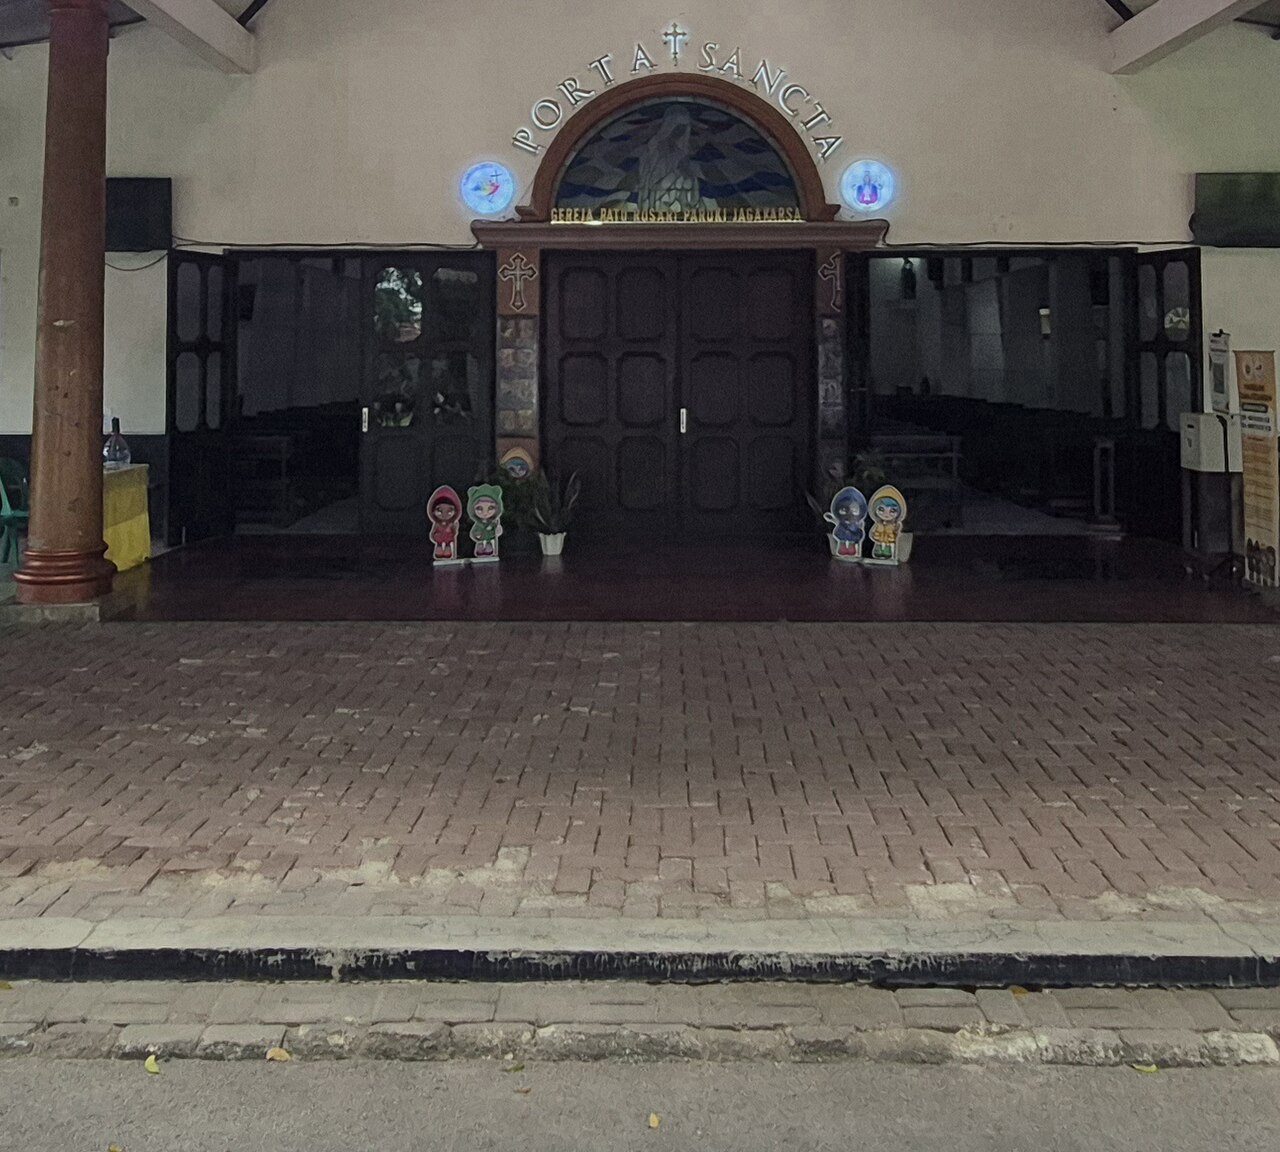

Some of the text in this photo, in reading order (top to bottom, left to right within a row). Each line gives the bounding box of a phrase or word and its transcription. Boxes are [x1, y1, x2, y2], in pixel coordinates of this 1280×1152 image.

[512, 41, 845, 162] PORTA SANCTA
[550, 207, 594, 222] GEREJA
[732, 207, 802, 222] JAGAKARSA
